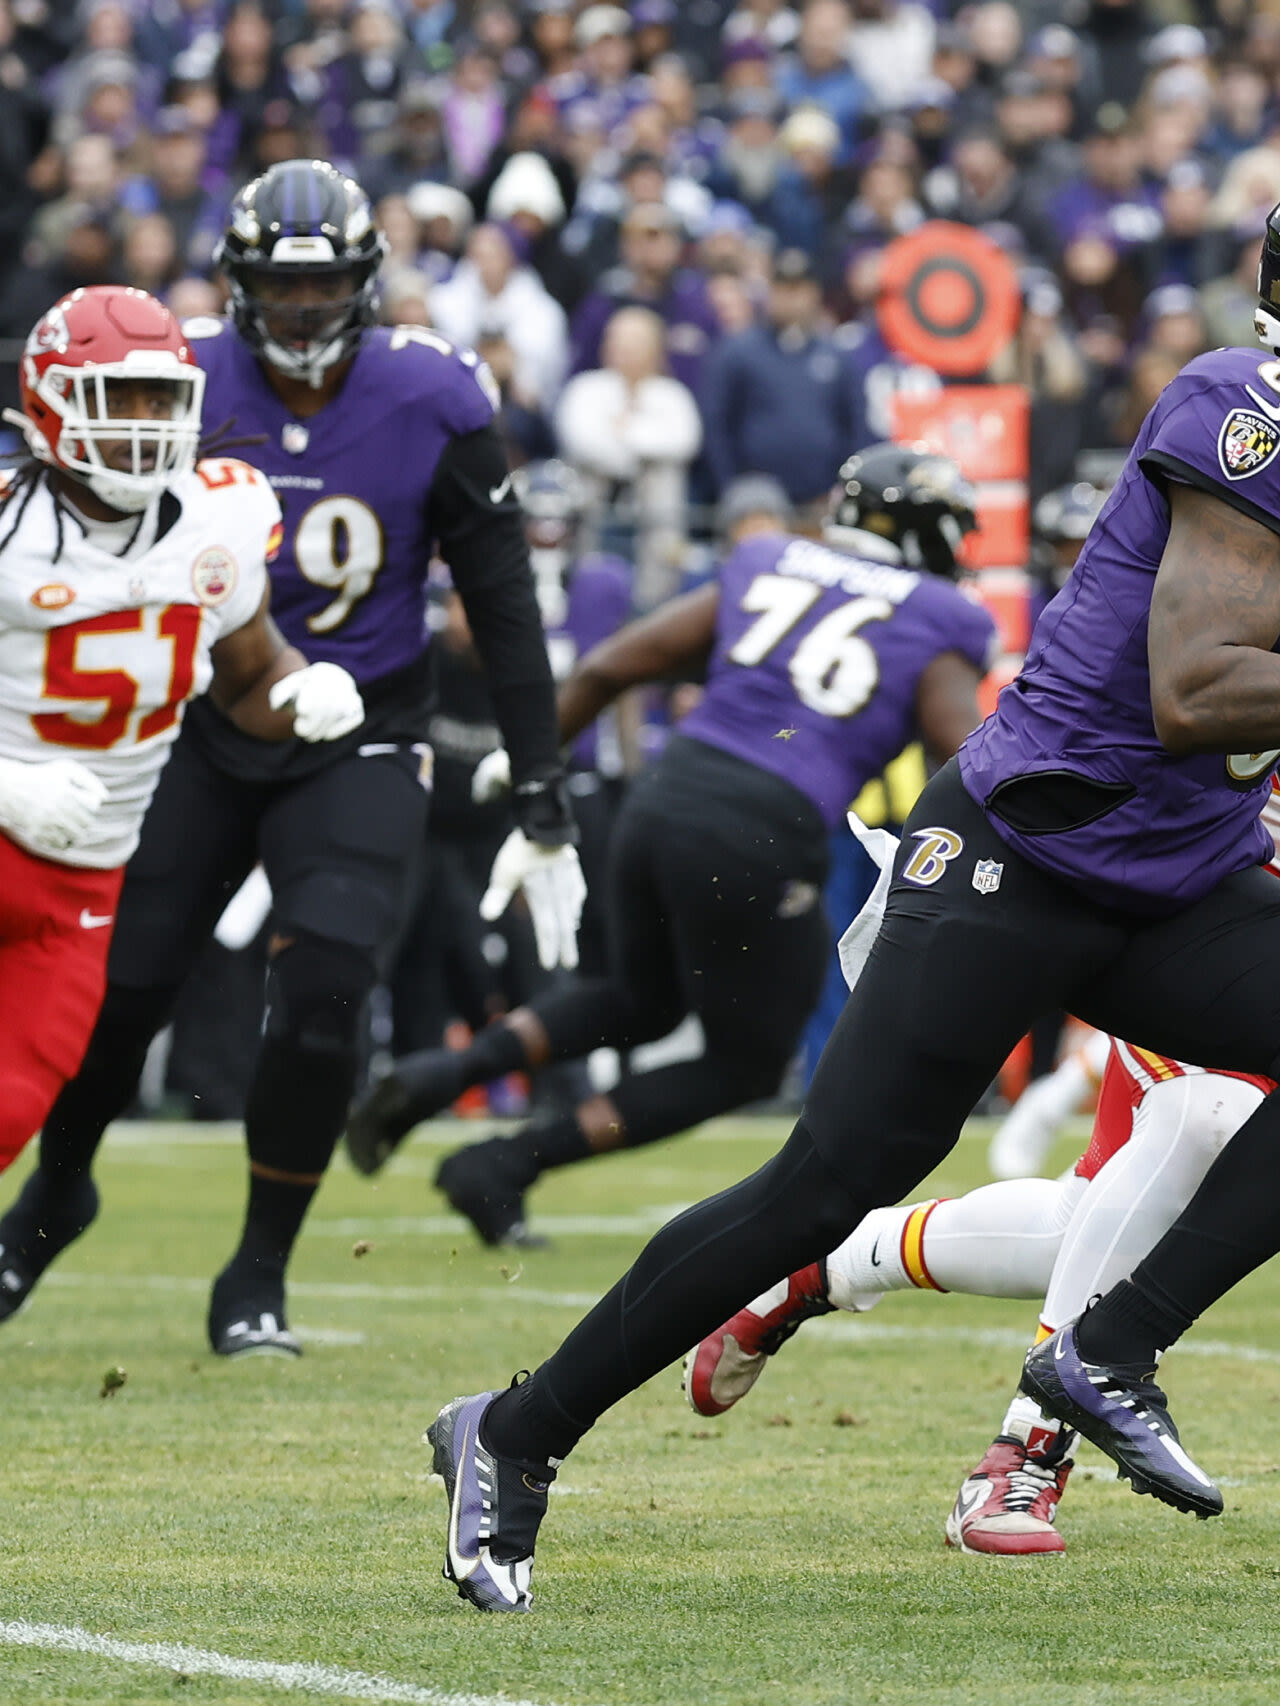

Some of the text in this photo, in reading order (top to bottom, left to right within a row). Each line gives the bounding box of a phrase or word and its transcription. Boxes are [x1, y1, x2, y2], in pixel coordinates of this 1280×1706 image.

[1234, 412, 1278, 440] RAVENS
[294, 494, 385, 634] 9
[29, 603, 204, 751] 51
[728, 572, 893, 718] 76
[902, 826, 964, 886] B
[976, 872, 996, 888] NFL
